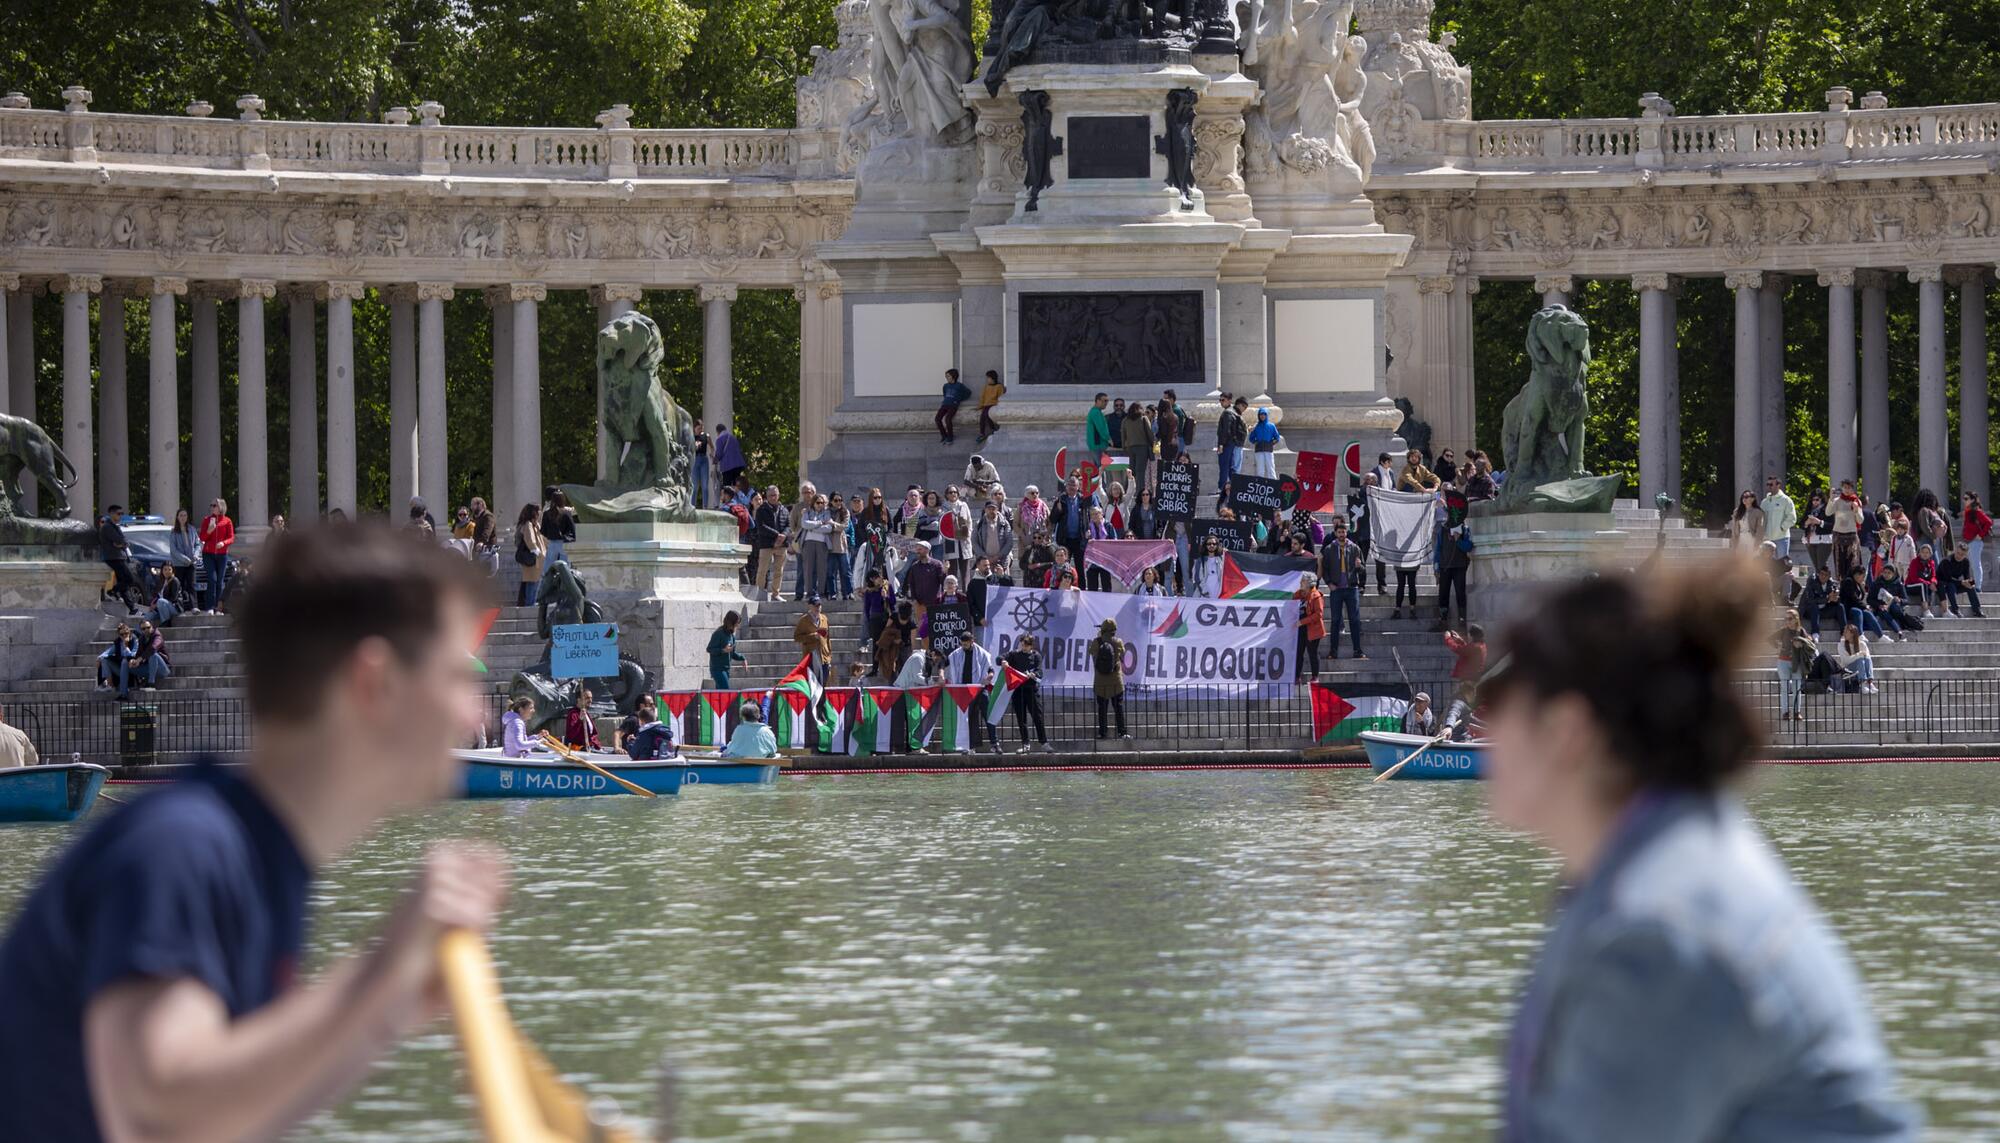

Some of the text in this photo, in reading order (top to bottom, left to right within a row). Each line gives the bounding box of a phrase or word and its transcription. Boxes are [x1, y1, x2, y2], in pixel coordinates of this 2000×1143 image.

[1171, 464, 1186, 473] NO
[1181, 484, 1192, 493] QUE
[1246, 482, 1274, 496] STOP
[1163, 491, 1186, 501] NO LO
[1208, 526, 1239, 538] ALTO EL
[1232, 538, 1245, 549] YA
[935, 611, 961, 620] FIN AL
[1195, 603, 1284, 628] GAZA
[933, 619, 967, 633] COMERCIO
[565, 631, 599, 641] FLOTILLA
[565, 649, 602, 659] LIBERTAD
[1145, 644, 1168, 678] EL
[1175, 645, 1285, 680] BLOQUEO
[1413, 751, 1471, 769] MADRID
[526, 773, 607, 790] MADRID
